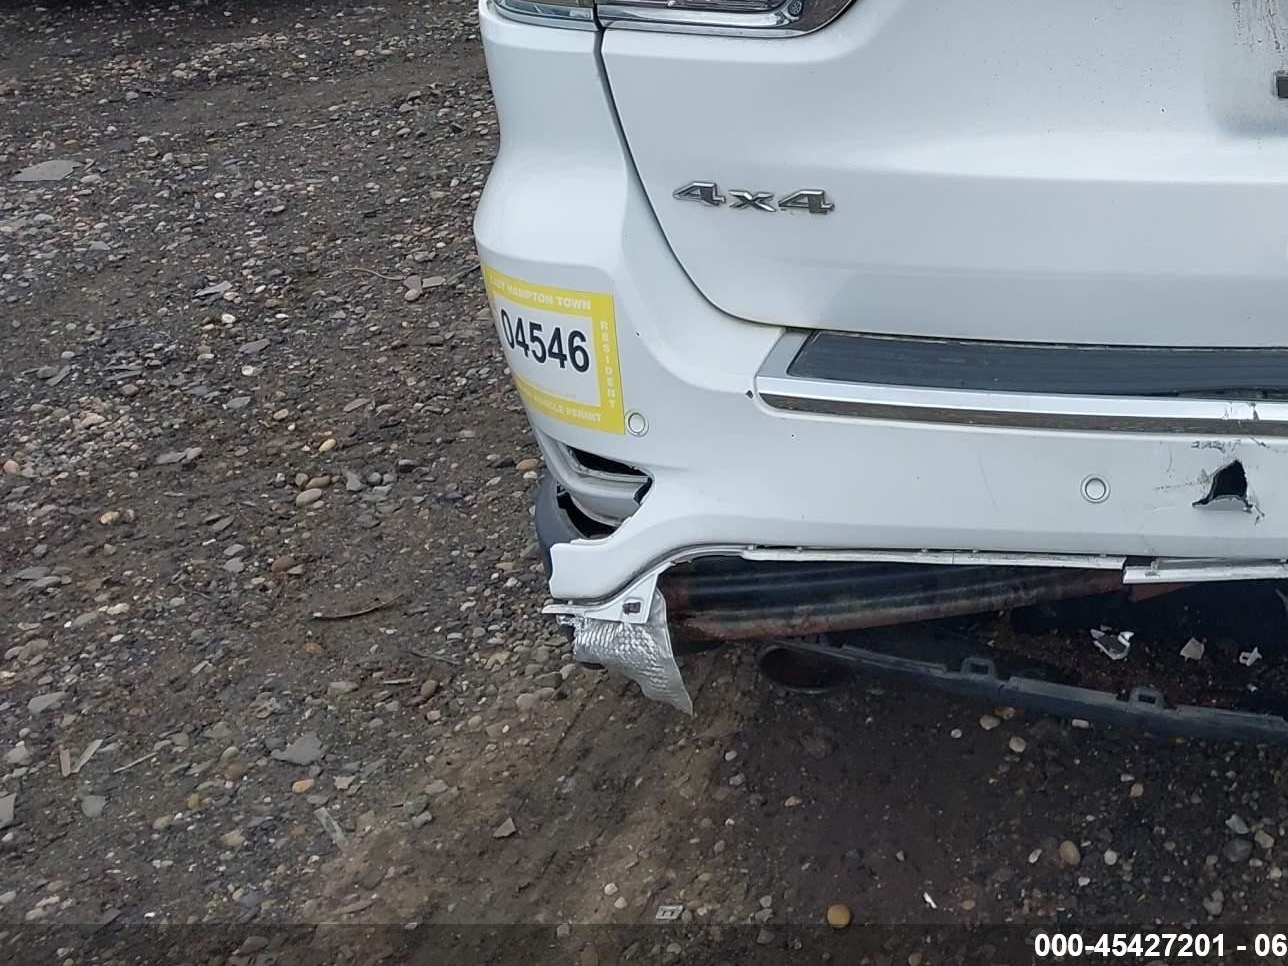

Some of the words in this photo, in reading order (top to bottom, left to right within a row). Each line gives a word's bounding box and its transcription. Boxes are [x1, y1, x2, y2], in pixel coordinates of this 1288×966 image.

[673, 181, 835, 215] 4x4
[557, 295, 592, 311] TOWN
[500, 309, 591, 373] 04546
